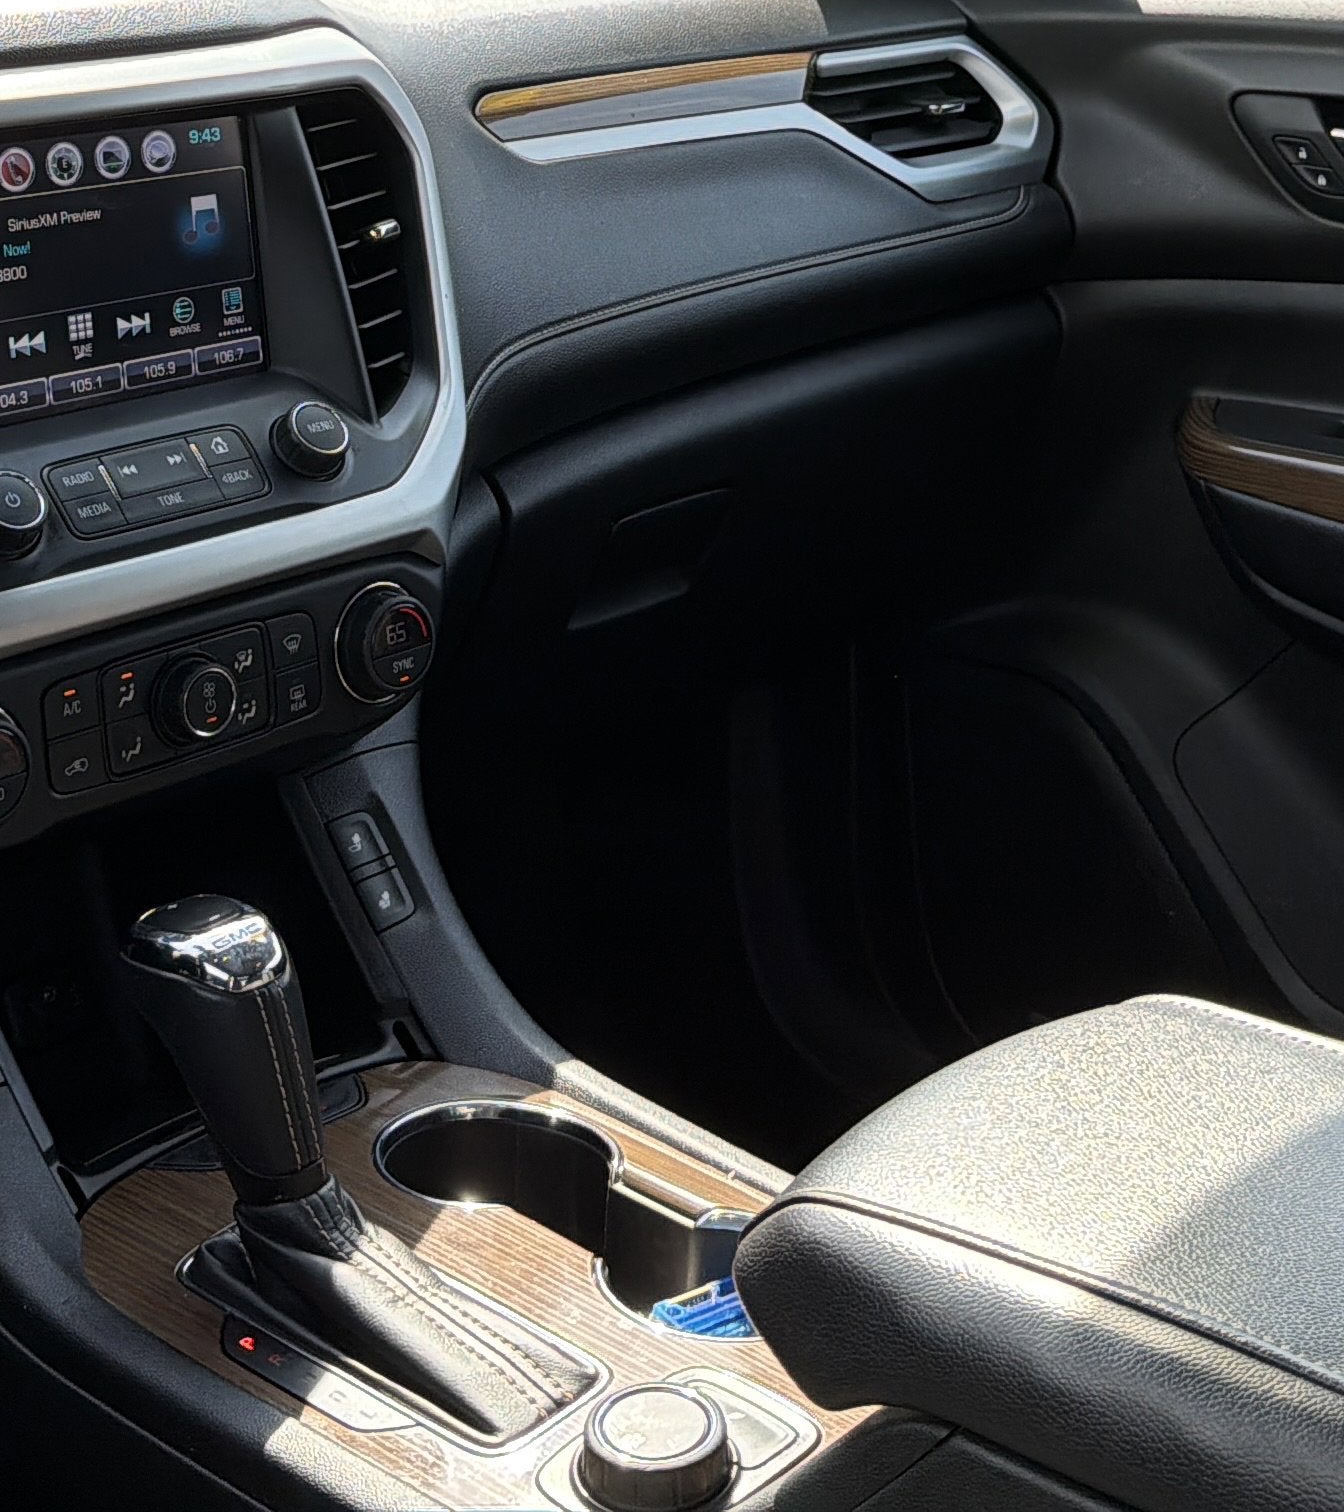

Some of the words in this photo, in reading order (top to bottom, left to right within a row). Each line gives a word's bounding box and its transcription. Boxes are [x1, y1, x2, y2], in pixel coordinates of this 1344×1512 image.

[188, 127, 221, 144] 9:43
[7, 211, 58, 232] SiriusXM
[59, 208, 102, 225] Preview
[3, 241, 32, 257] Now!
[223, 315, 245, 327] MENU
[169, 323, 202, 337] BROWSE
[71, 343, 93, 356] TUNE
[213, 348, 244, 365] 106.7
[143, 361, 176, 379] 105.9
[70, 375, 103, 394] 105.1
[306, 419, 336, 434] MENU
[62, 470, 95, 488] RADIO
[227, 469, 254, 484] BACK
[157, 491, 184, 507] TONE
[77, 502, 112, 519] MEDIA
[386, 622, 406, 645] 65
[392, 656, 415, 674] SYNC
[63, 700, 82, 717] A/C
[211, 922, 262, 949] GMC
